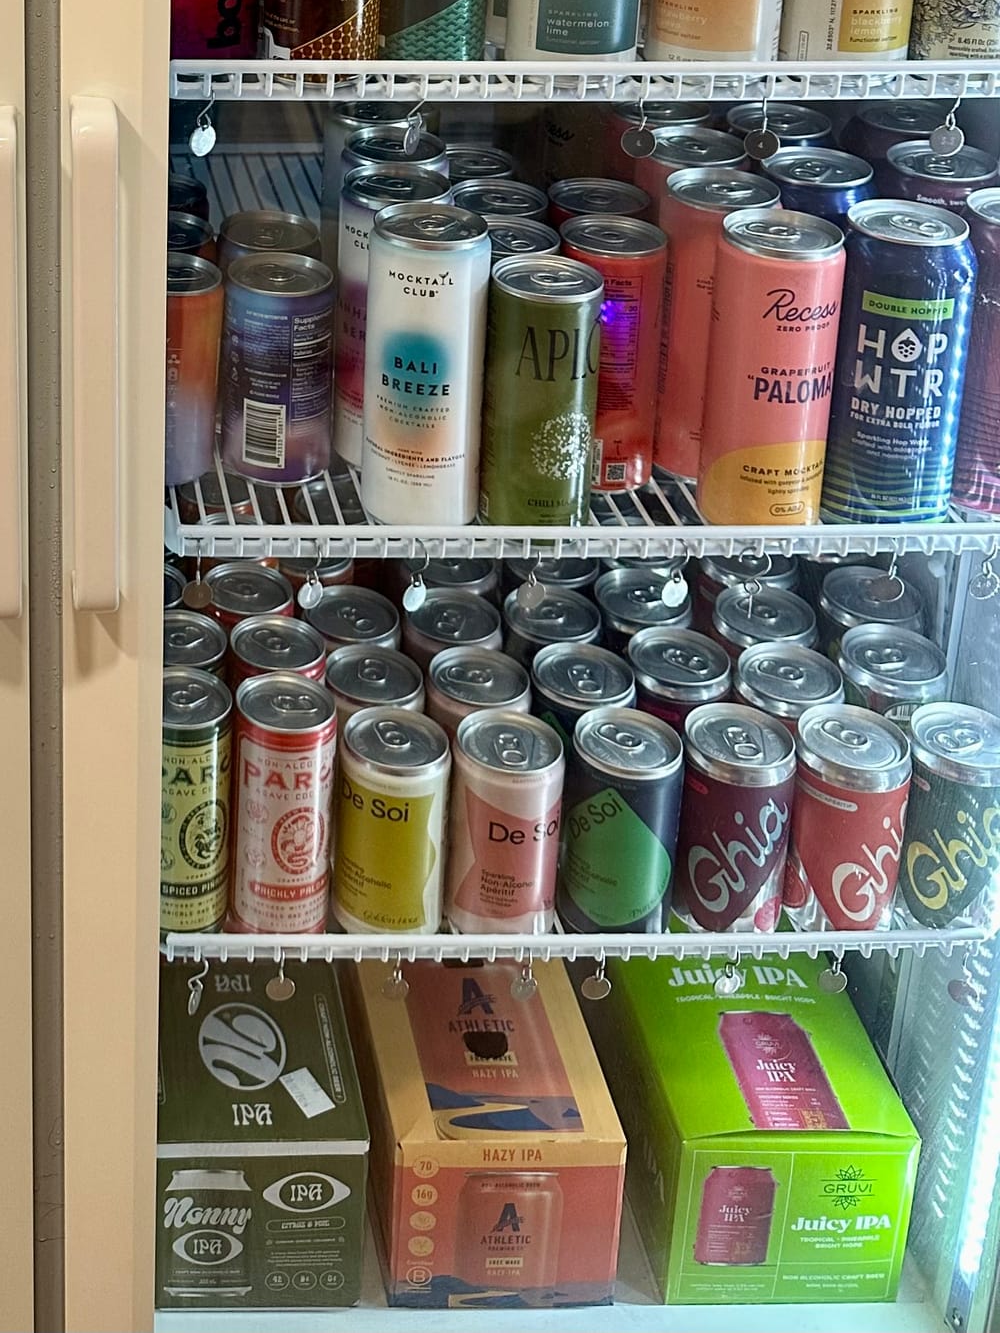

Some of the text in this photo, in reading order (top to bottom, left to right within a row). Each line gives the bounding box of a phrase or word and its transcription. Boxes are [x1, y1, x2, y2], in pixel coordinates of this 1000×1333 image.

[546, 25, 569, 37] lime
[547, 17, 610, 29] watermelon
[402, 286, 435, 298] CLUB
[762, 287, 838, 323] Recess
[868, 299, 949, 316] DOUBLE HOPPED
[776, 324, 802, 333] ZERO
[393, 356, 438, 374] BALI
[760, 361, 831, 378] GRAPEFRUIT
[382, 373, 450, 397] BREEZE
[854, 360, 944, 399] WTR
[379, 404, 447, 421] NON-ALCOHOLIC
[851, 397, 942, 420] DRY HOPPED
[865, 416, 891, 428] EXTRA
[743, 465, 780, 477] CRAFT
[371, 798, 409, 823] Soi
[569, 792, 623, 840] De Soi
[488, 821, 525, 845] De
[687, 797, 789, 913] Ghia
[162, 883, 198, 895] SPICED
[752, 966, 808, 989] IPA
[756, 1059, 796, 1073] Juicy
[766, 1070, 796, 1083] IPA
[231, 1103, 273, 1126] IPA
[482, 1149, 543, 1163] HAZY IPA
[419, 1160, 433, 1172] 70
[290, 1183, 323, 1201] IPA
[416, 1188, 434, 1203] 16g
[164, 1196, 252, 1235] Nonny
[718, 1204, 751, 1216] Juicy
[722, 1213, 746, 1223] IPA
[790, 1214, 892, 1234] Juicy IPA
[192, 1238, 223, 1255] IPA
[480, 1234, 532, 1246] ATHLETIC
